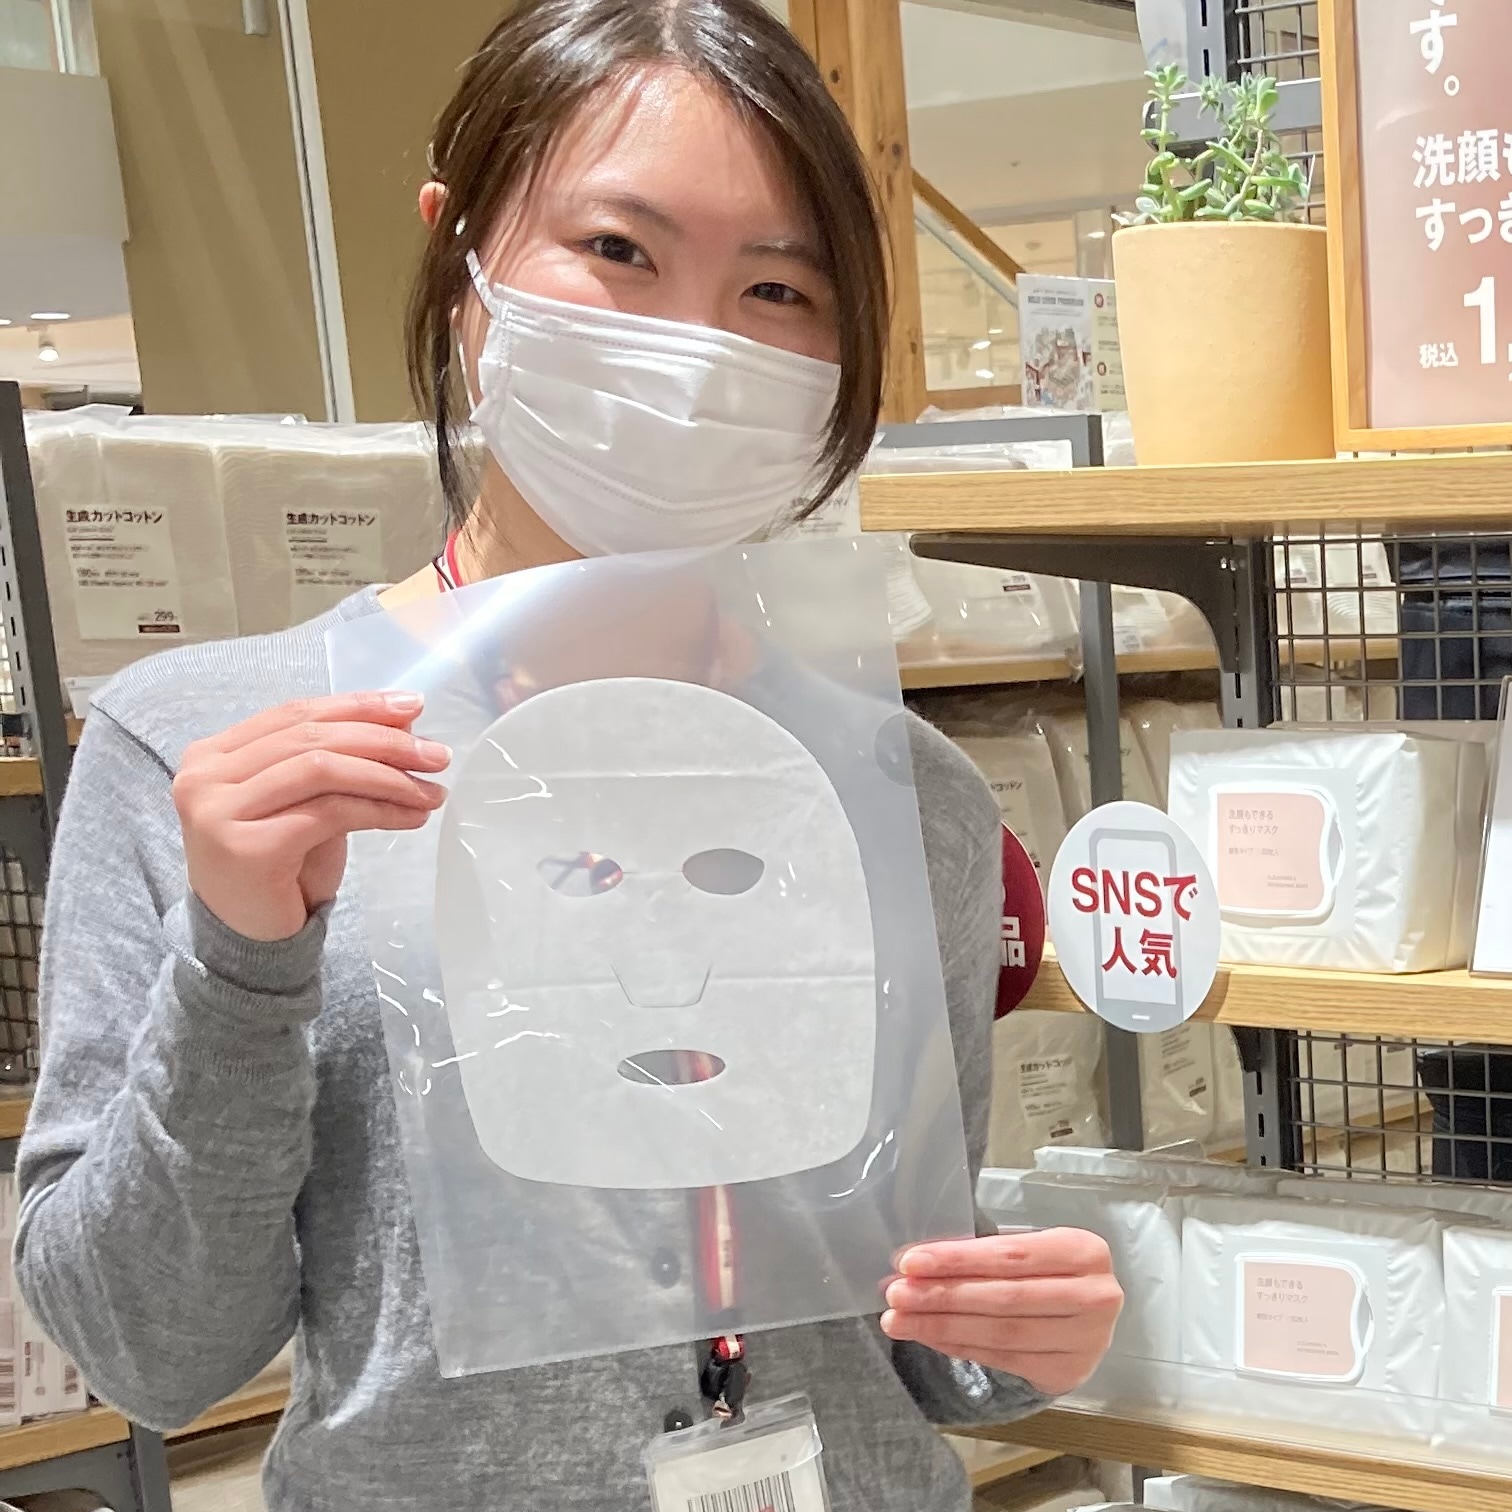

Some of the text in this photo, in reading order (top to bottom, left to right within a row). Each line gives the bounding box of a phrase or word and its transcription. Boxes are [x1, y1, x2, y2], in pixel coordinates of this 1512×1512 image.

[1419, 342, 1459, 368] 税込
[1071, 867, 1198, 921] SNSで
[1102, 926, 1178, 979] 人気
